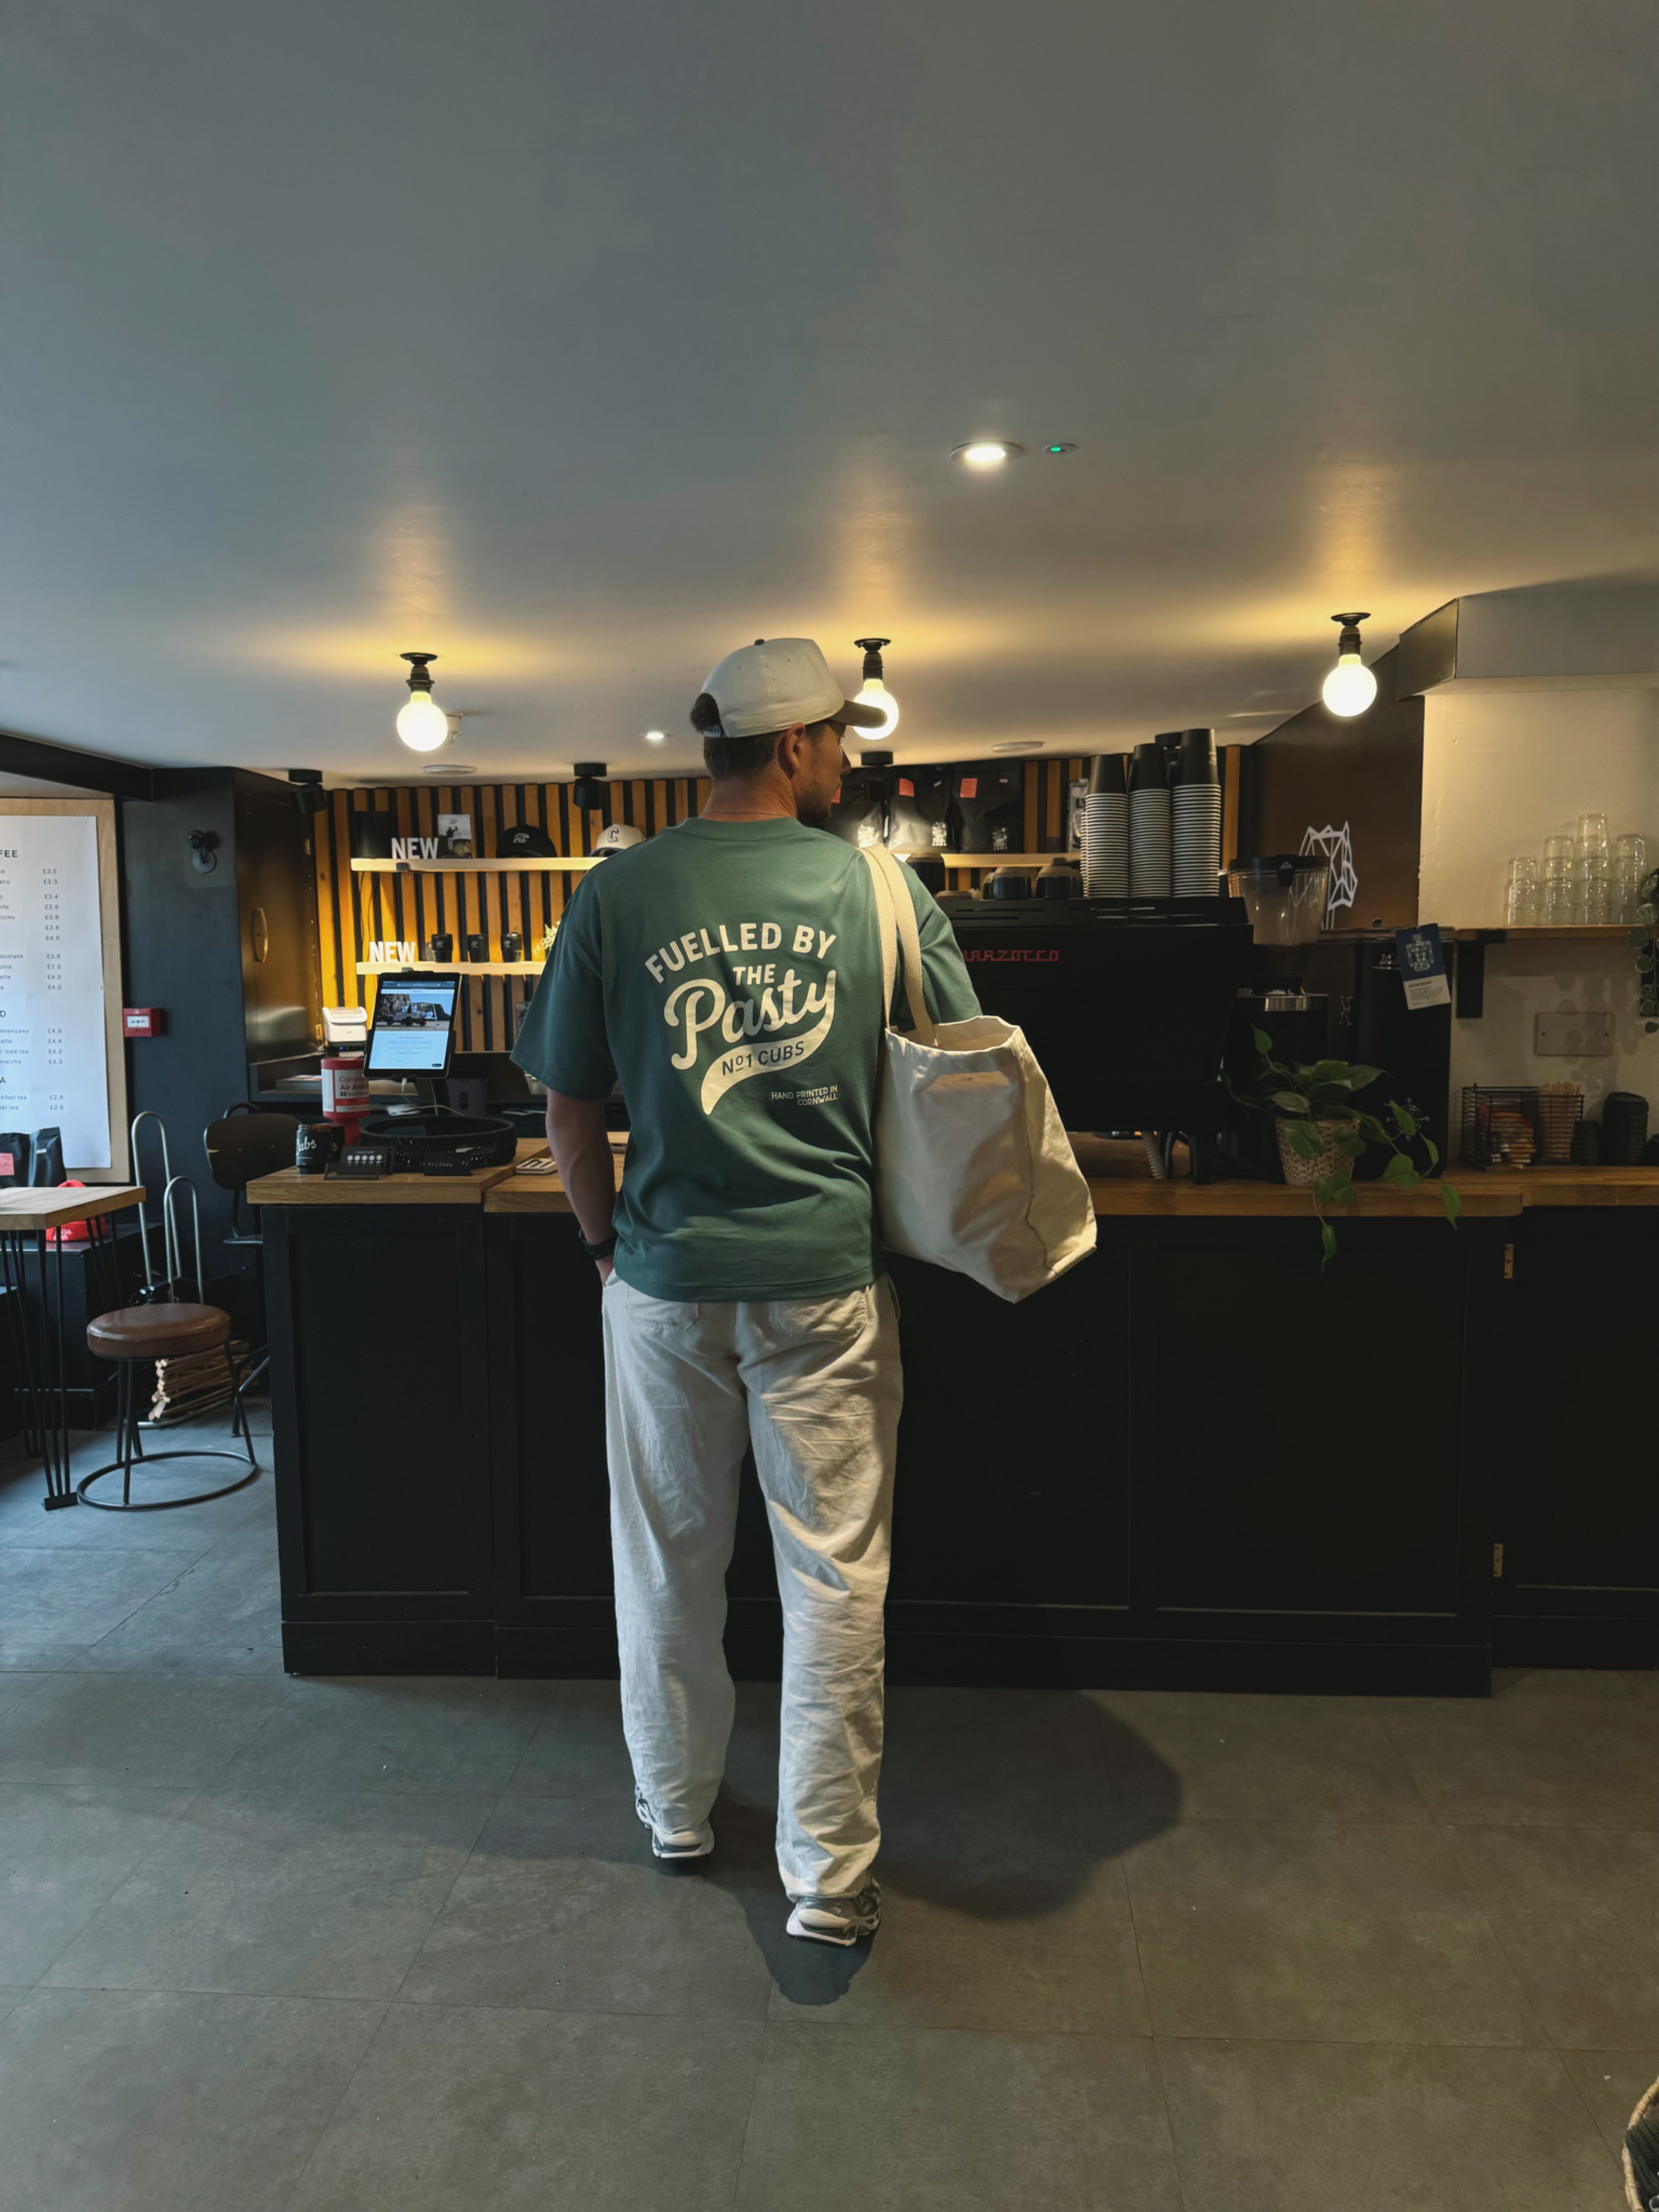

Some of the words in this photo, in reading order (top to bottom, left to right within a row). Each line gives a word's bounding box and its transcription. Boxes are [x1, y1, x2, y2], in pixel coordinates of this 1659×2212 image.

[391, 837, 439, 859] NEW
[369, 941, 416, 963] NEW
[645, 922, 782, 983] FUELLED
[793, 925, 836, 960] BY
[733, 963, 776, 986] THE
[664, 969, 837, 1070] Pasty
[758, 1041, 805, 1066] CUBS
[771, 1091, 794, 1100] HAND
[796, 1087, 828, 1099] PRINTED
[830, 1084, 838, 1093] IN
[798, 1093, 838, 1106] CORNWALL
